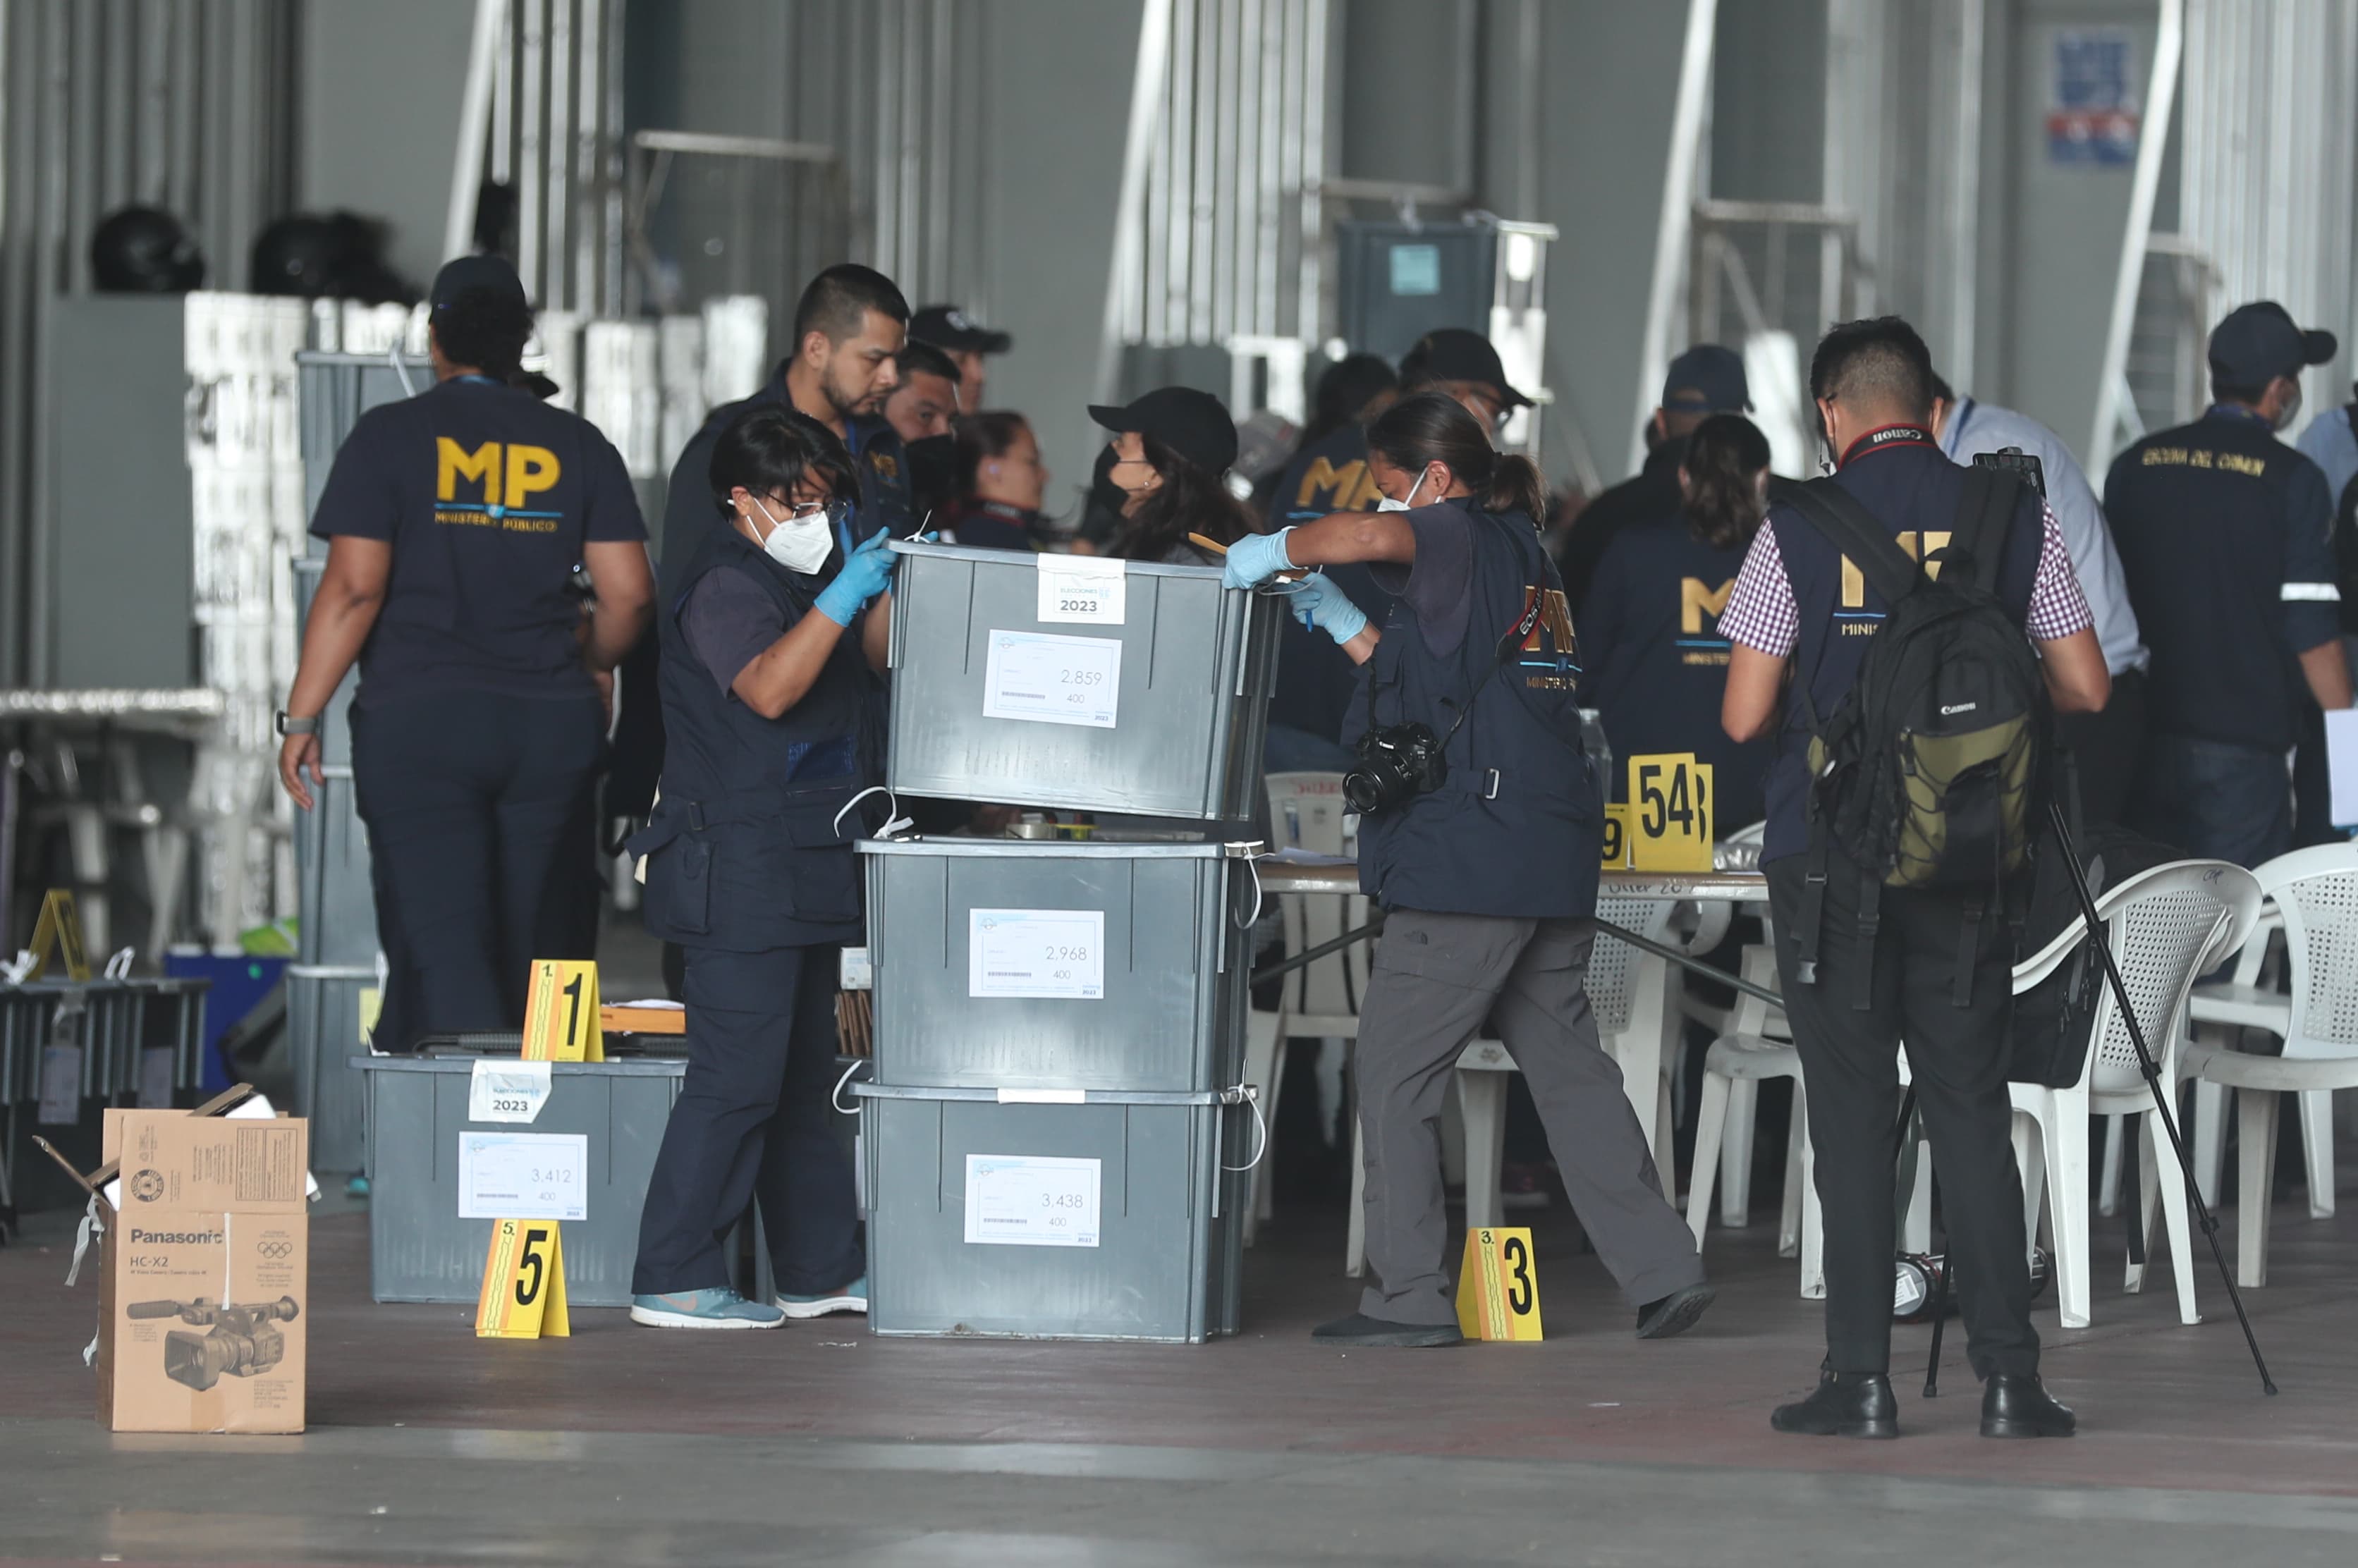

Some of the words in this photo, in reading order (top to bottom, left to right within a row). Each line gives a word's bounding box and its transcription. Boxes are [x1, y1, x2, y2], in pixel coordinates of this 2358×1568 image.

[1873, 429, 1923, 443] Canon
[435, 435, 561, 509] MP
[1060, 599, 1098, 612] 2023
[1061, 669, 1103, 687] 2,859
[1066, 694, 1085, 704] 400
[1940, 702, 1977, 716] Canon
[1639, 763, 1694, 839] 54
[1045, 945, 1088, 962] 2,968
[1053, 969, 1071, 980] 400
[563, 972, 583, 1047] 1
[493, 1099, 529, 1112] 2023
[539, 1192, 556, 1201] 400
[1041, 1193, 1084, 1208] 3,438
[503, 1222, 515, 1236] 5.
[1049, 1218, 1068, 1227] 400
[130, 1228, 224, 1244] Panasonic
[1481, 1230, 1495, 1245] 3.
[130, 1256, 169, 1268] HC-X2
[515, 1229, 549, 1306] 5
[1504, 1237, 1533, 1316] 3
